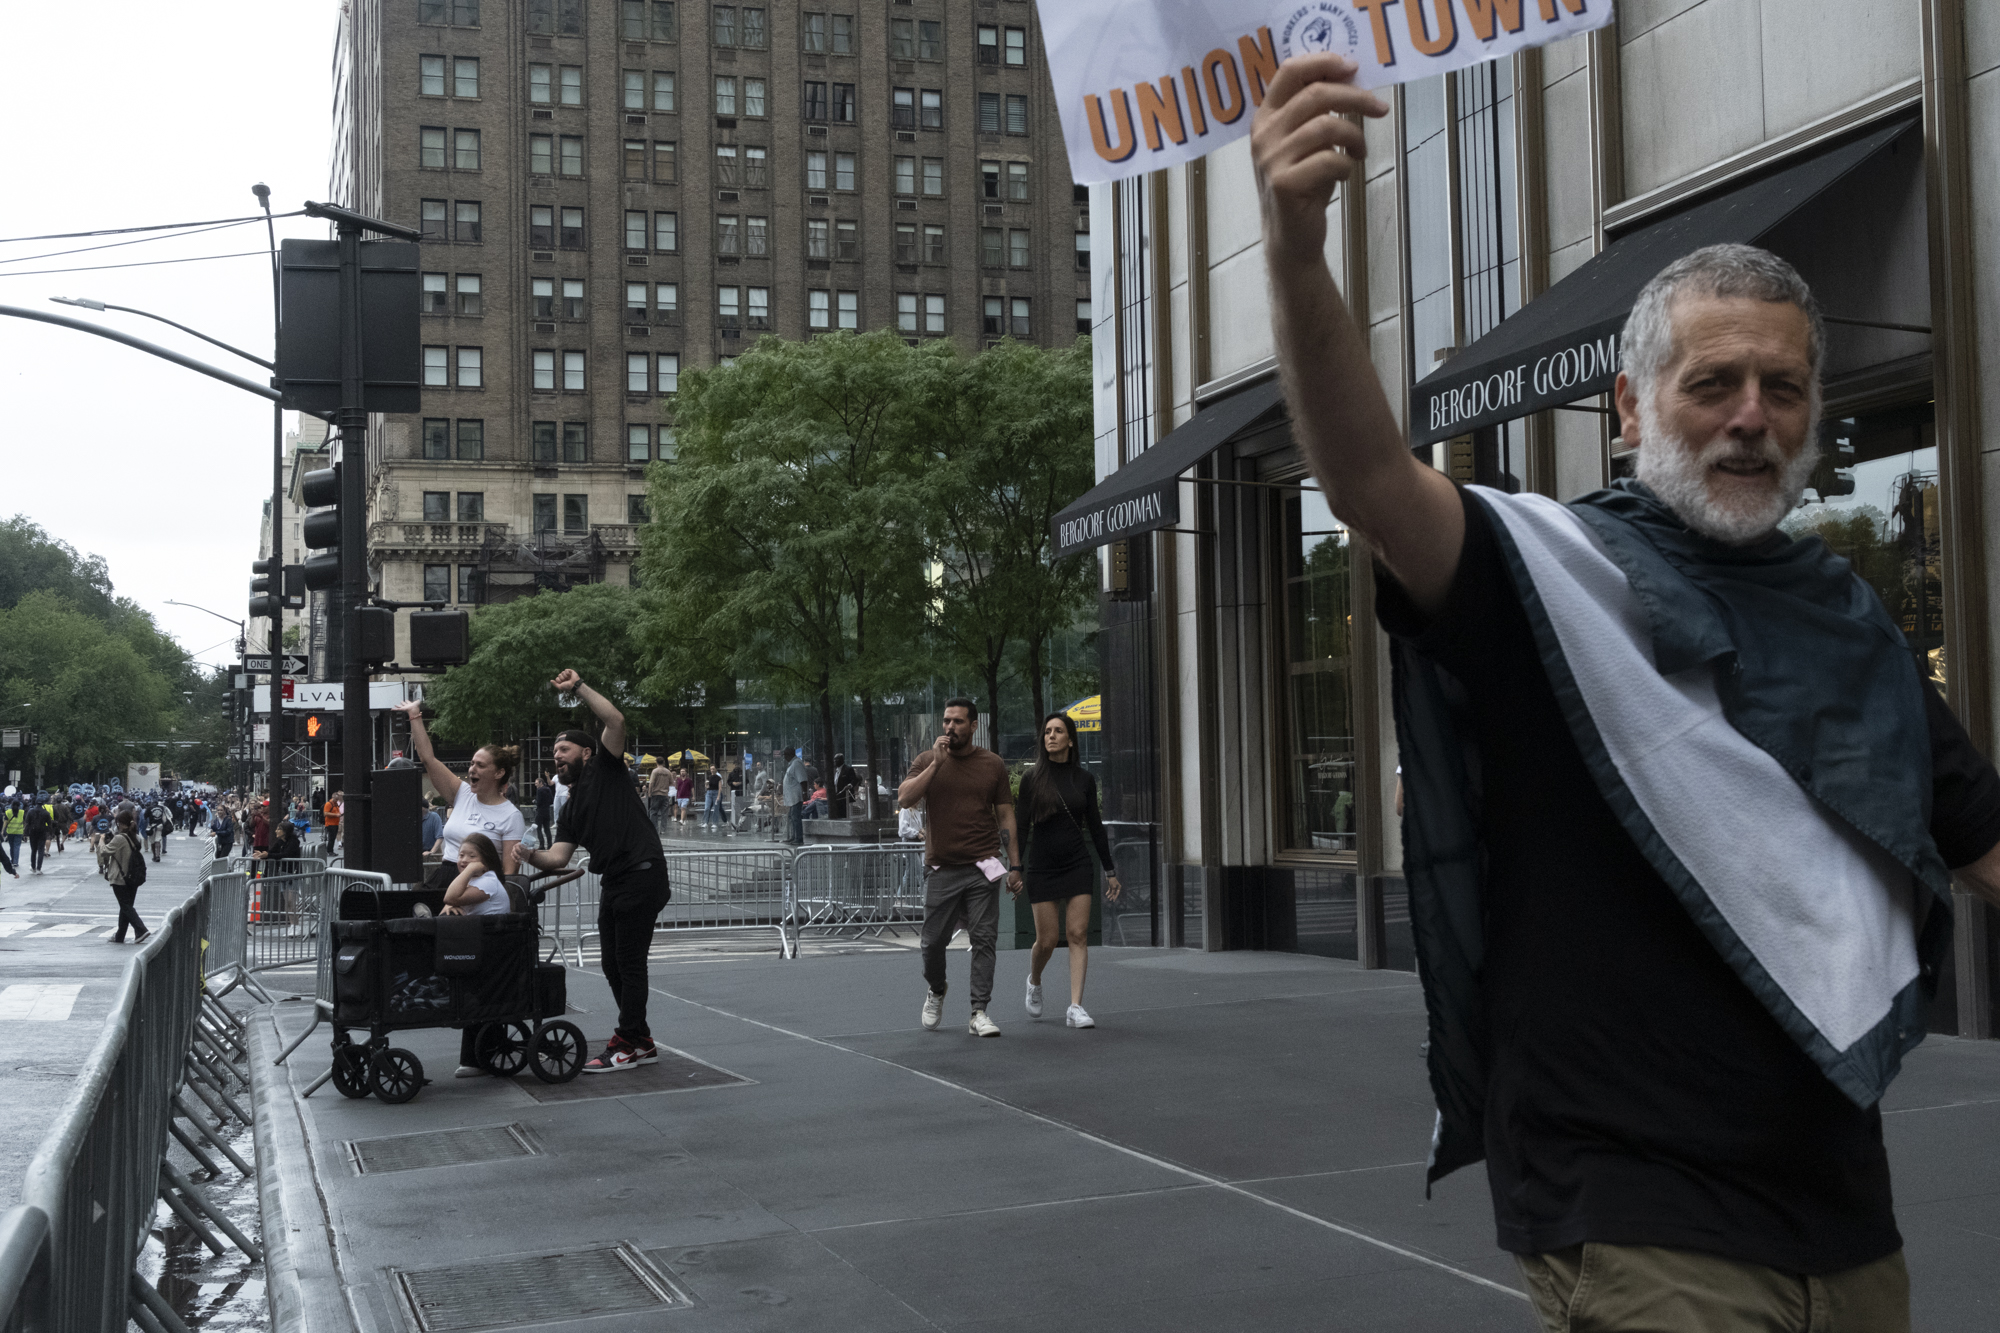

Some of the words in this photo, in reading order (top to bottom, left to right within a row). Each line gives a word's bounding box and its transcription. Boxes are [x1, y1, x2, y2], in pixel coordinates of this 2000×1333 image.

[1282, 6, 1309, 45] WORKERS
[1320, 2, 1344, 17] MANY
[1343, 14, 1359, 46] VOICES
[1083, 25, 1279, 163] UNION
[1430, 364, 1526, 431] BERGDORF
[1060, 510, 1104, 548] BERGDORF
[1107, 491, 1161, 532] GOODMAN
[250, 660, 268, 669] ONE
[282, 660, 297, 669] AY
